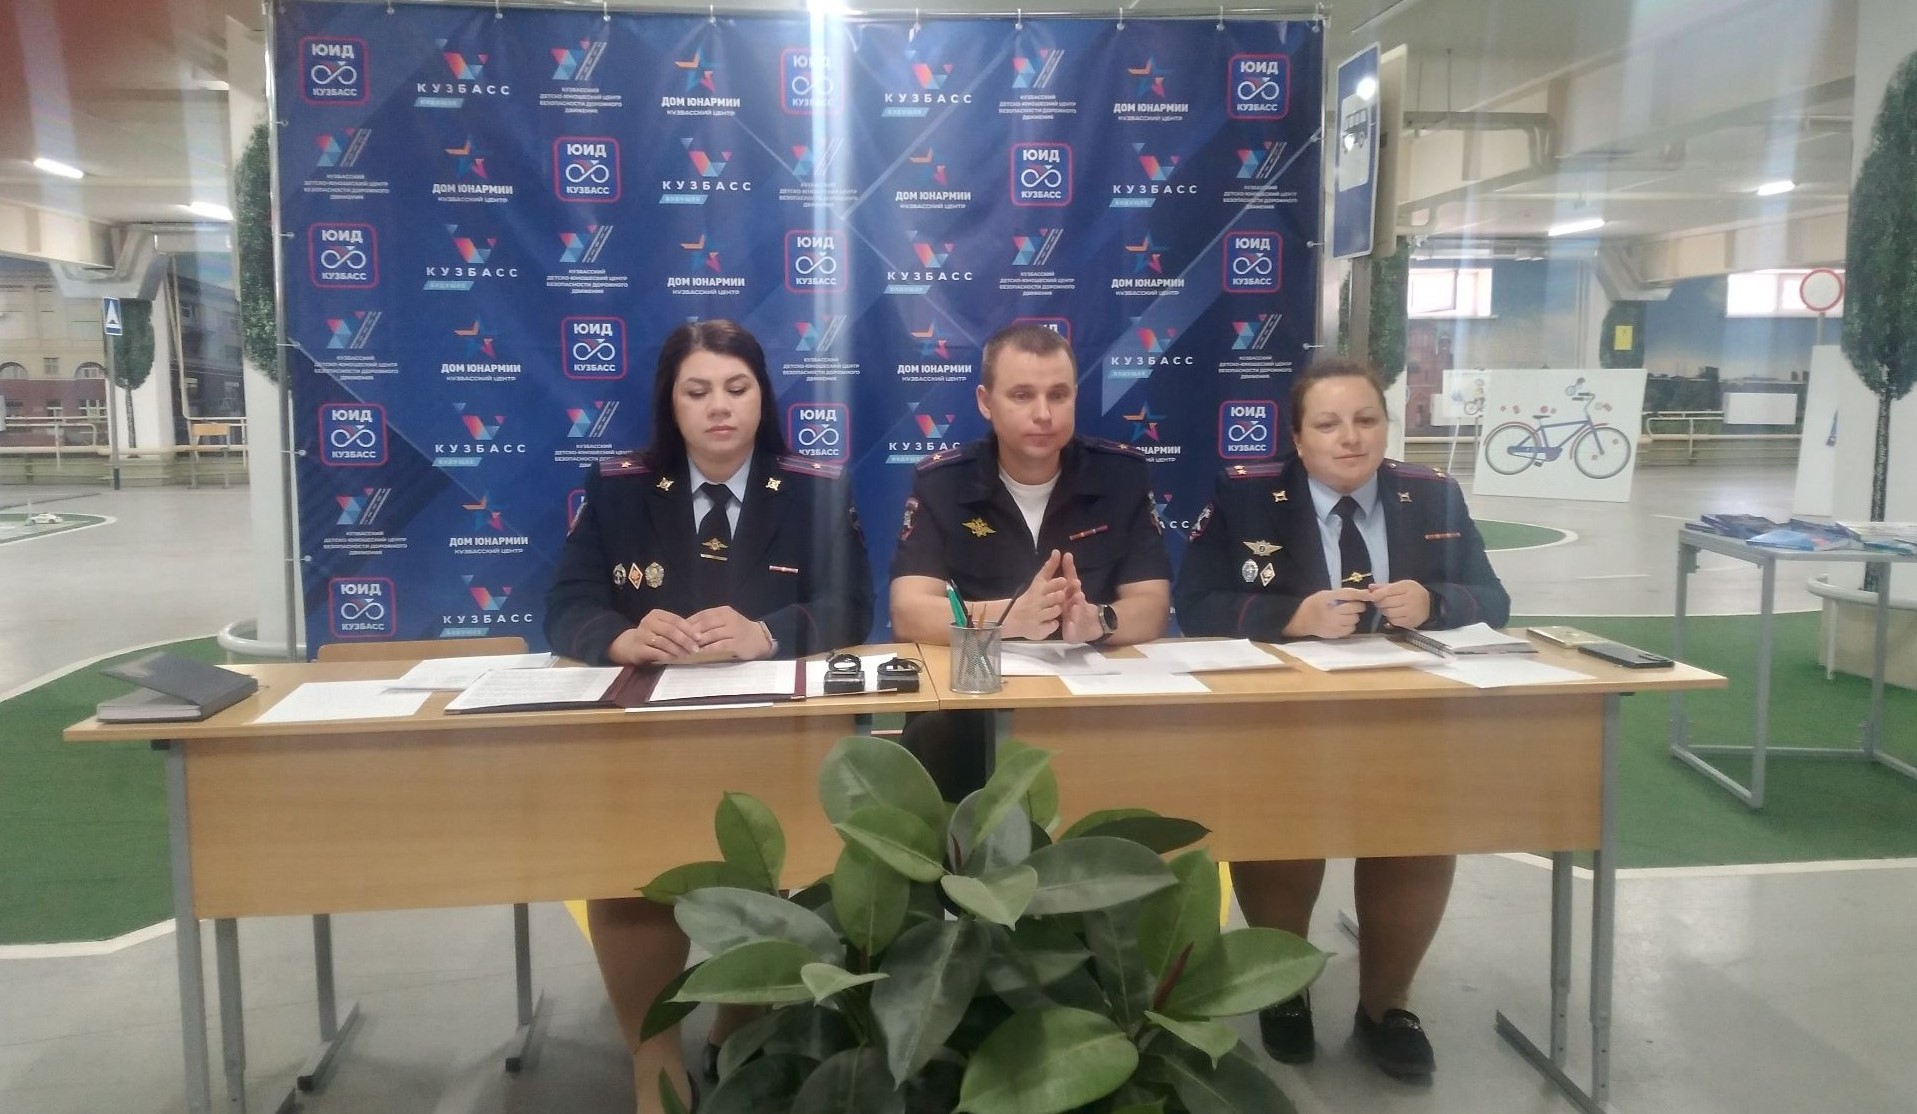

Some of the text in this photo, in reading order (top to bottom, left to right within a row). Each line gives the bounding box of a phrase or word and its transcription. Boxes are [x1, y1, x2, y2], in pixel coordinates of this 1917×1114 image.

[311, 44, 355, 58] ЮИД
[1240, 61, 1279, 74] ЮИД
[312, 88, 357, 96] КУЗБАСС
[417, 83, 510, 95] КУЗБАСС
[661, 96, 741, 108] ДОМ ЮНАРМИИ
[884, 93, 972, 104] КУЗБАСС
[1113, 103, 1189, 114] ДОМ ЮНАРМИИ
[566, 144, 607, 157] ЮИД
[1023, 150, 1060, 163] ЮИД
[432, 184, 513, 194] ДОМ ЮНАРМИИ
[566, 186, 610, 194] КУЗБАСС
[662, 181, 751, 191] КУЗБАСС
[1113, 184, 1198, 194] КУЗБАСС
[895, 192, 971, 202] ДОМ ЮНАРМИИ
[1021, 191, 1062, 199] КУЗБАСС
[321, 229, 364, 243] ЮИД
[797, 236, 834, 250] ЮИД
[1235, 238, 1271, 250] ЮИД
[426, 267, 518, 278] КУЗБАСС
[887, 271, 973, 281] КУЗБАСС
[667, 278, 745, 288] ДОМ ЮНАРМИИ
[796, 277, 836, 285] КУЗБАСС
[1111, 278, 1185, 288] ДОМ ЮНАРМИИ
[573, 322, 613, 336] ЮИД
[1111, 356, 1194, 366] КУЗБАСС
[441, 364, 521, 374] ДОМ ЮНАРМИИ
[573, 364, 616, 372] КУЗБАСС
[897, 364, 972, 374] ДОМ ЮНАРМИИ
[332, 409, 373, 423] ЮИД
[800, 409, 837, 422] ЮИД
[1230, 406, 1266, 418] ЮИД
[435, 444, 526, 453] КУЗБАСС
[889, 442, 961, 451] КУЗБАС
[1136, 446, 1181, 454] НАРМИИ
[449, 537, 529, 547] ДОМ ЮНАРМИИ
[340, 583, 382, 596] ЮИД
[443, 614, 533, 624] КУЗБАСС
[341, 622, 385, 631] КУЗБАСС
